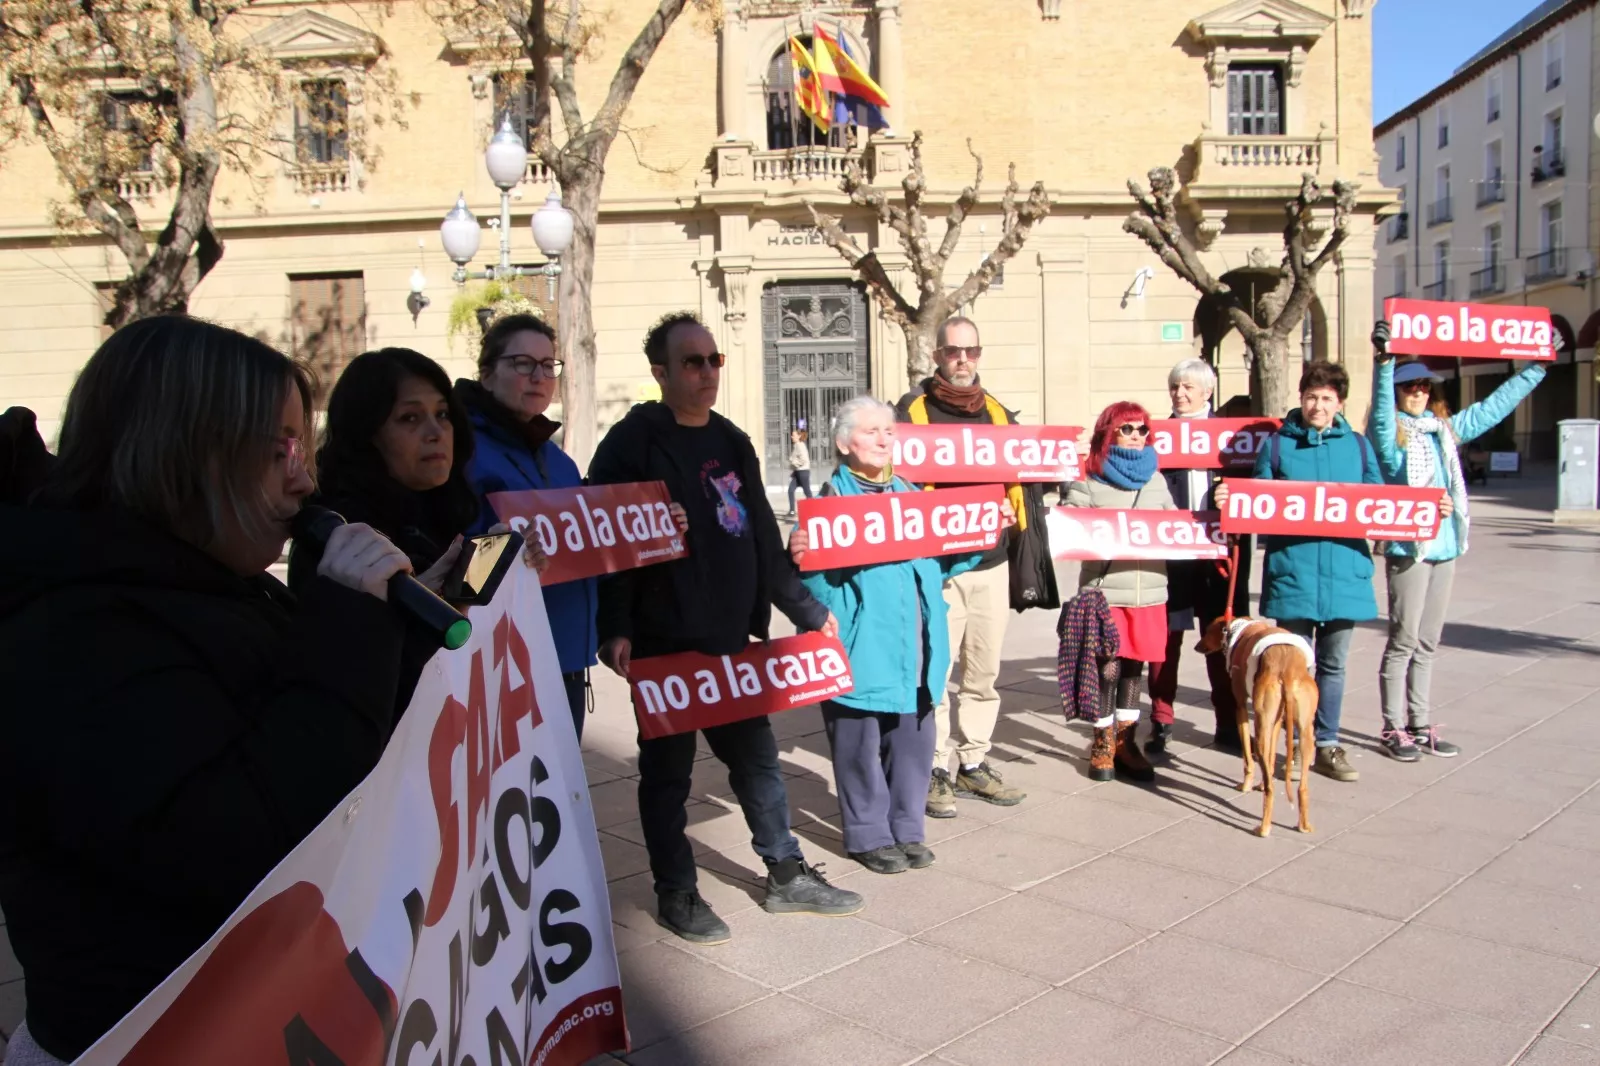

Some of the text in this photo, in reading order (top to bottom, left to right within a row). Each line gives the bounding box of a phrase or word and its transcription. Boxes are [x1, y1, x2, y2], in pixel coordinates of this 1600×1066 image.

[1391, 313, 1431, 340] no
[1436, 315, 1454, 343] a
[1459, 306, 1487, 343] la
[1491, 318, 1551, 346] caza
[934, 437, 956, 466] a
[962, 427, 996, 466] la
[1003, 438, 1079, 467] caza
[1153, 422, 1278, 455] a la caz
[558, 511, 585, 552] a
[575, 494, 616, 548] la
[616, 501, 677, 543] caza
[807, 514, 857, 550] no
[864, 511, 886, 545] a
[890, 497, 925, 542] la
[931, 501, 999, 538] caza
[1228, 486, 1437, 526] no a la caza
[1117, 511, 1151, 546] la
[637, 647, 847, 715] no a la caza
